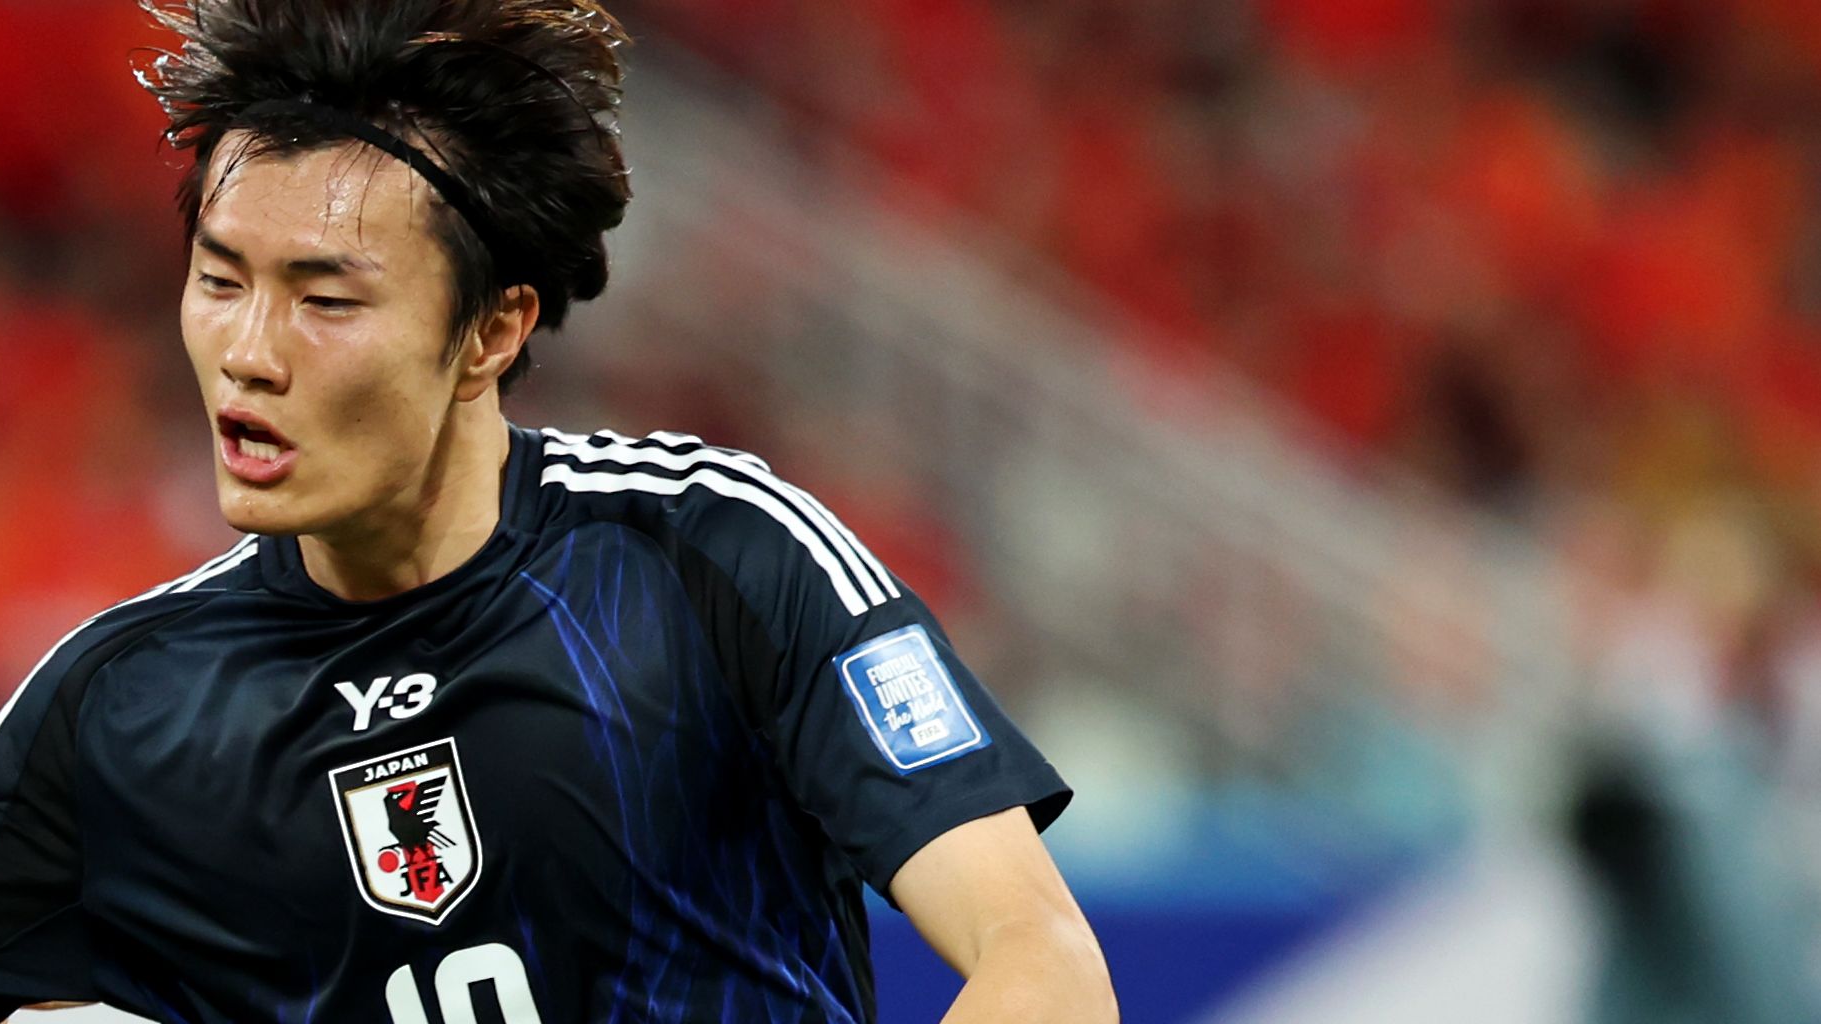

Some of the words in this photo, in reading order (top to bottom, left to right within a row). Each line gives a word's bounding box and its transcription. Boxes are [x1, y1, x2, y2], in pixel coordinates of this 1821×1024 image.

[334, 673, 437, 731] Y-3
[916, 725, 941, 741] FIFA
[363, 752, 429, 782] JAPAN
[399, 862, 454, 898] JFA
